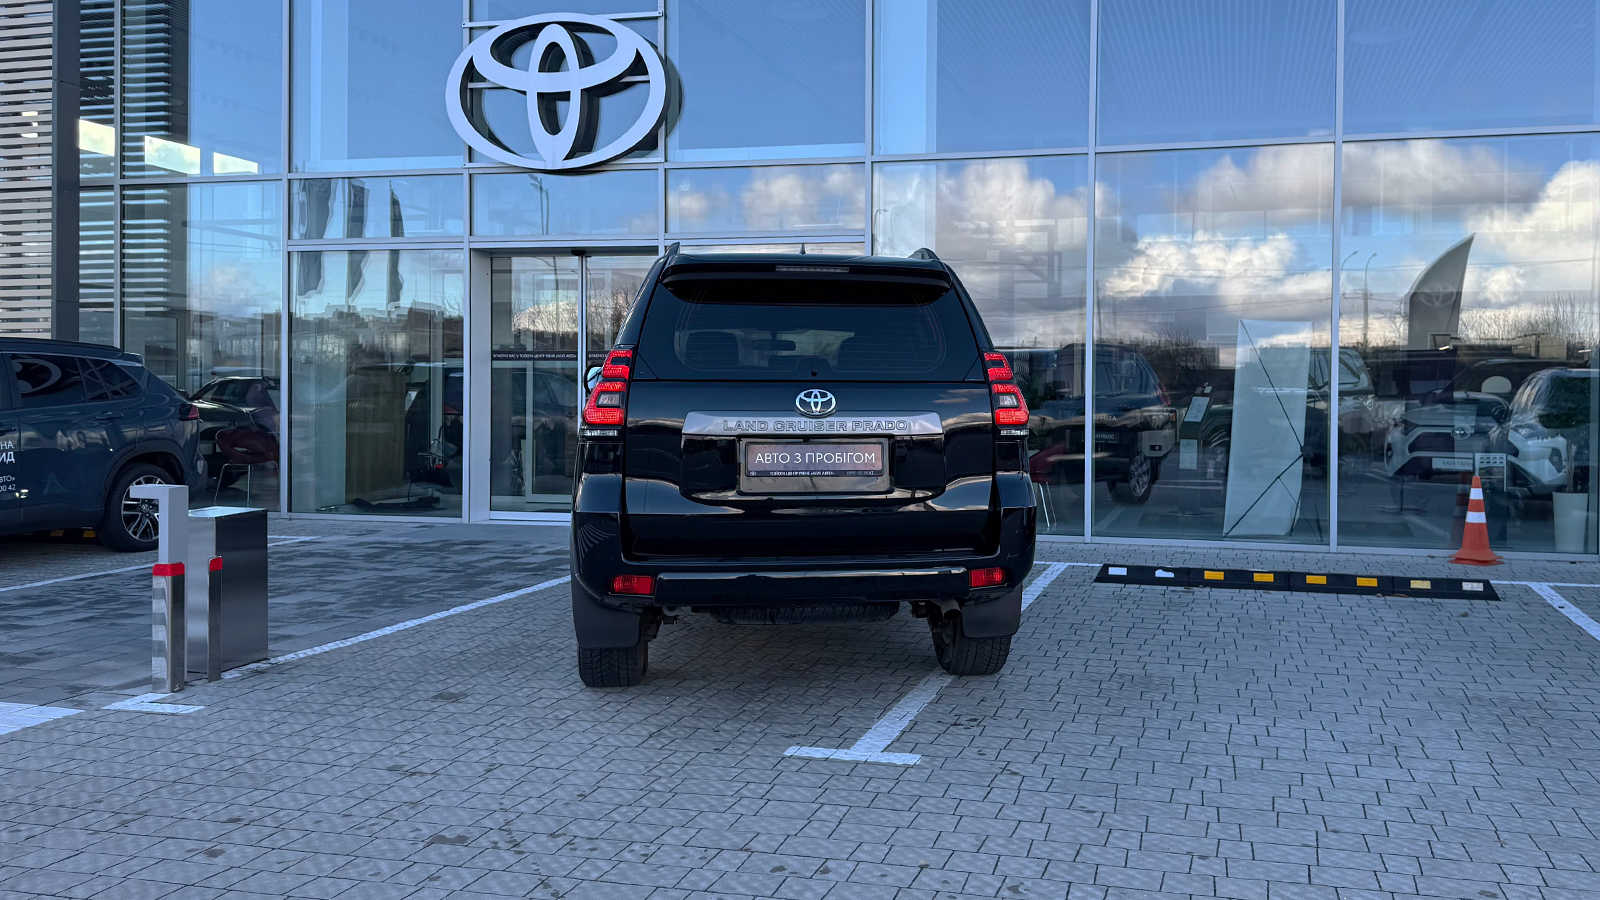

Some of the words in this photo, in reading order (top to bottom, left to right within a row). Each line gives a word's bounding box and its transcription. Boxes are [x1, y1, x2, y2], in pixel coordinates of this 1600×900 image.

[722, 420, 769, 432] LAND
[773, 420, 848, 432] CRUISER
[851, 420, 908, 431] PRADO
[755, 452, 790, 464] АВТО
[805, 452, 876, 464] ПРОБІГОМ
